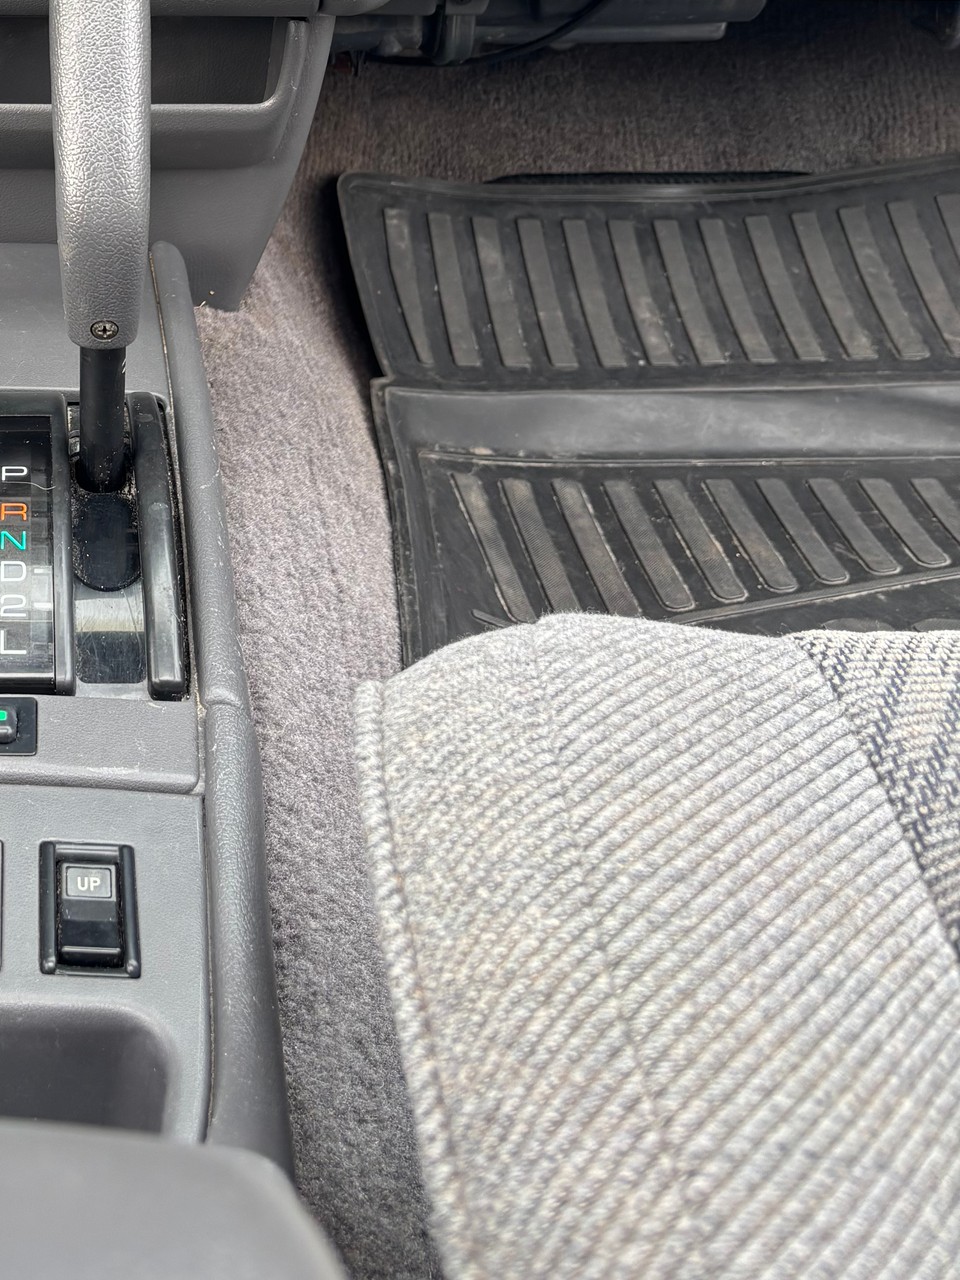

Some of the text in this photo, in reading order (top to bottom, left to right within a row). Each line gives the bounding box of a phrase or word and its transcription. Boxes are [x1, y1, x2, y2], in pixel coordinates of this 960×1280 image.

[1, 466, 28, 481] P
[0, 503, 27, 521] R
[0, 531, 27, 550] N
[0, 561, 27, 582] D
[0, 595, 27, 617] 2
[0, 630, 27, 654] L
[77, 876, 101, 891] UP
